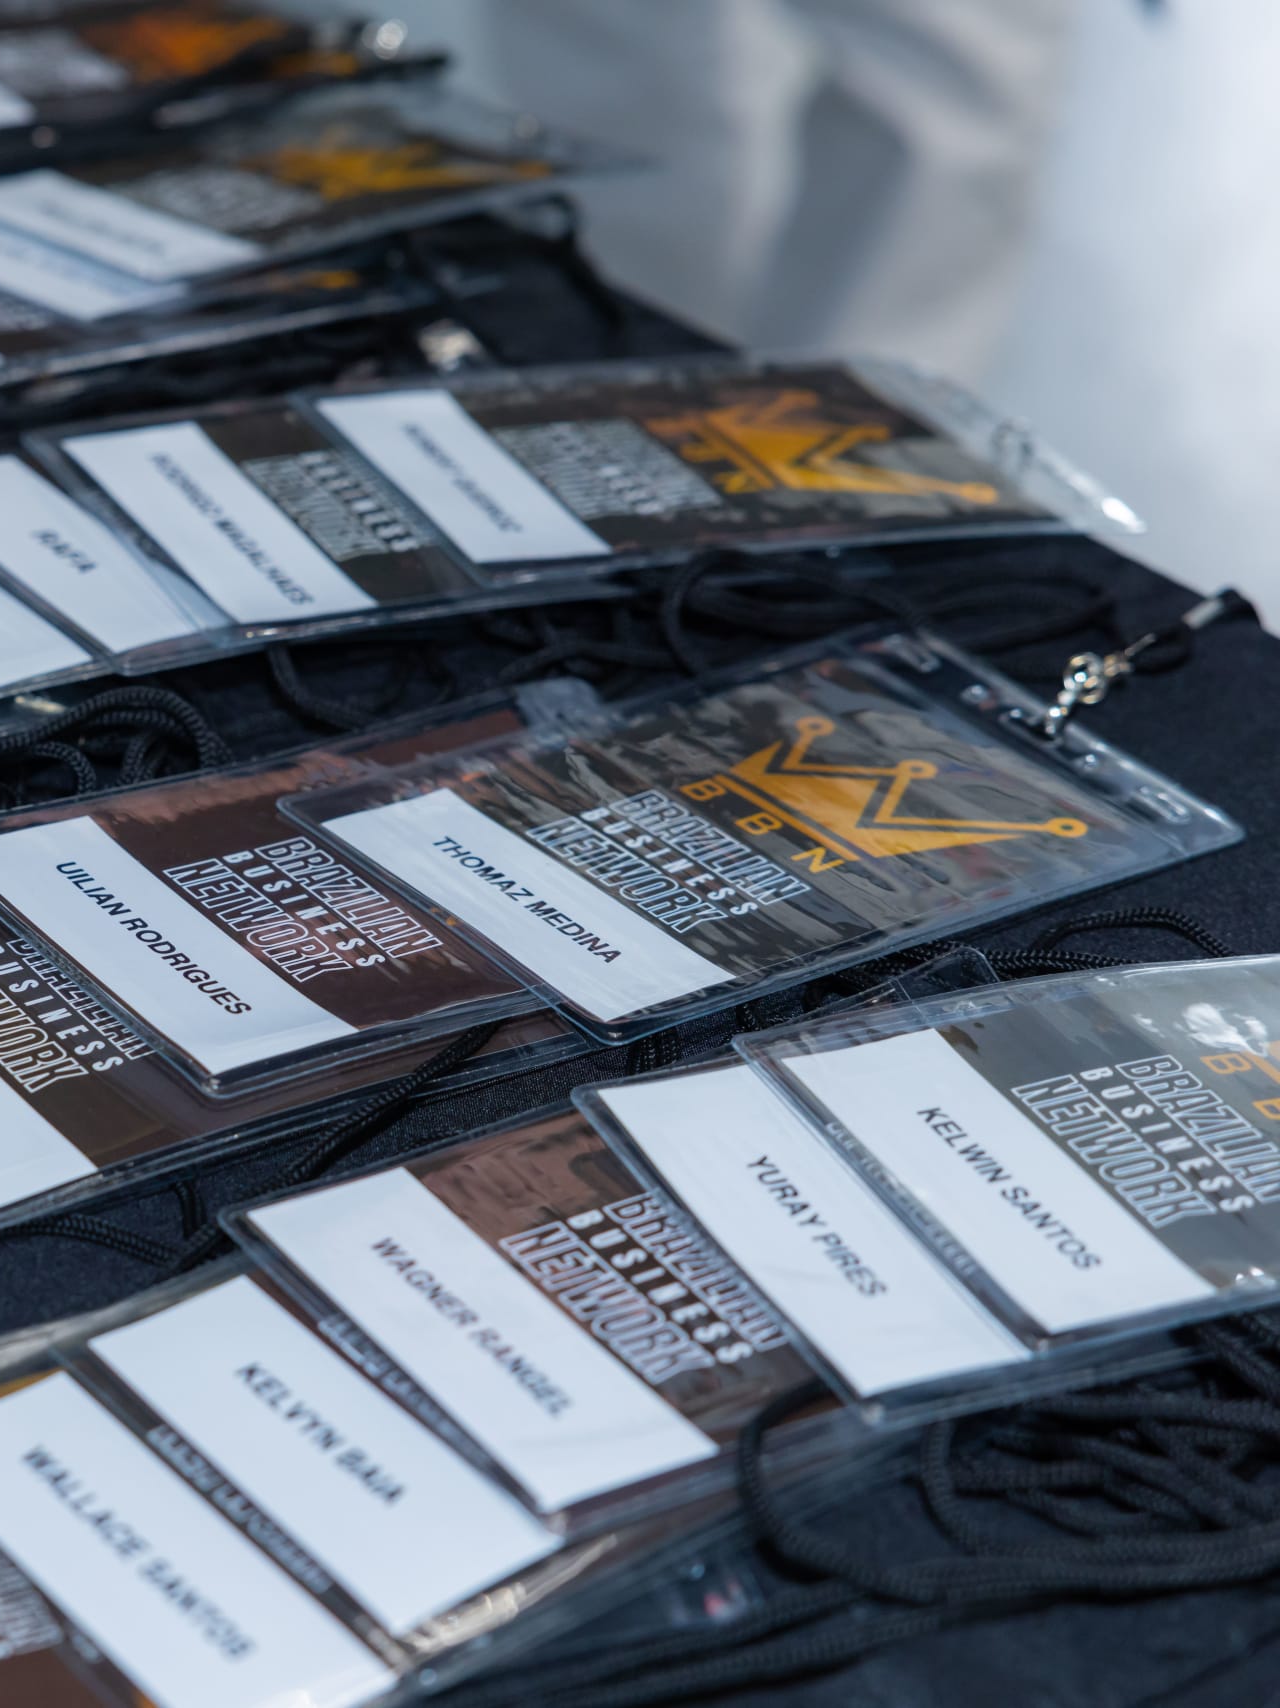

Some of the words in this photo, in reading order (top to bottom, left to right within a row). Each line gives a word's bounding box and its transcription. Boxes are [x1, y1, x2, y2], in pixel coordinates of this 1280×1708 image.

[222, 850, 386, 967] BUSINESS
[255, 835, 445, 958] BRAZILIAN
[433, 836, 533, 902] THOMAZ
[526, 901, 622, 964] MEDINA
[525, 817, 732, 933] NETWORK
[580, 808, 759, 916] BUSINESS
[608, 790, 812, 905] BRAZILIAN
[55, 861, 133, 918] UILIAN
[120, 915, 253, 1016] RODRIGUES
[162, 858, 344, 982] NETWORK
[916, 1106, 1012, 1184] KELWIN
[1000, 1185, 1103, 1269] SANTOS
[1011, 1074, 1218, 1229] NETWORK
[1080, 1066, 1255, 1212] BUSINESS
[372, 1237, 479, 1328] WAGNER
[567, 1209, 754, 1364] BUSINESS
[747, 1154, 827, 1231] YURAY
[812, 1231, 889, 1298] PIRES
[498, 1220, 717, 1385] NETWORK
[235, 1361, 344, 1453] KELVYN
[22, 1445, 150, 1564] WALLACE
